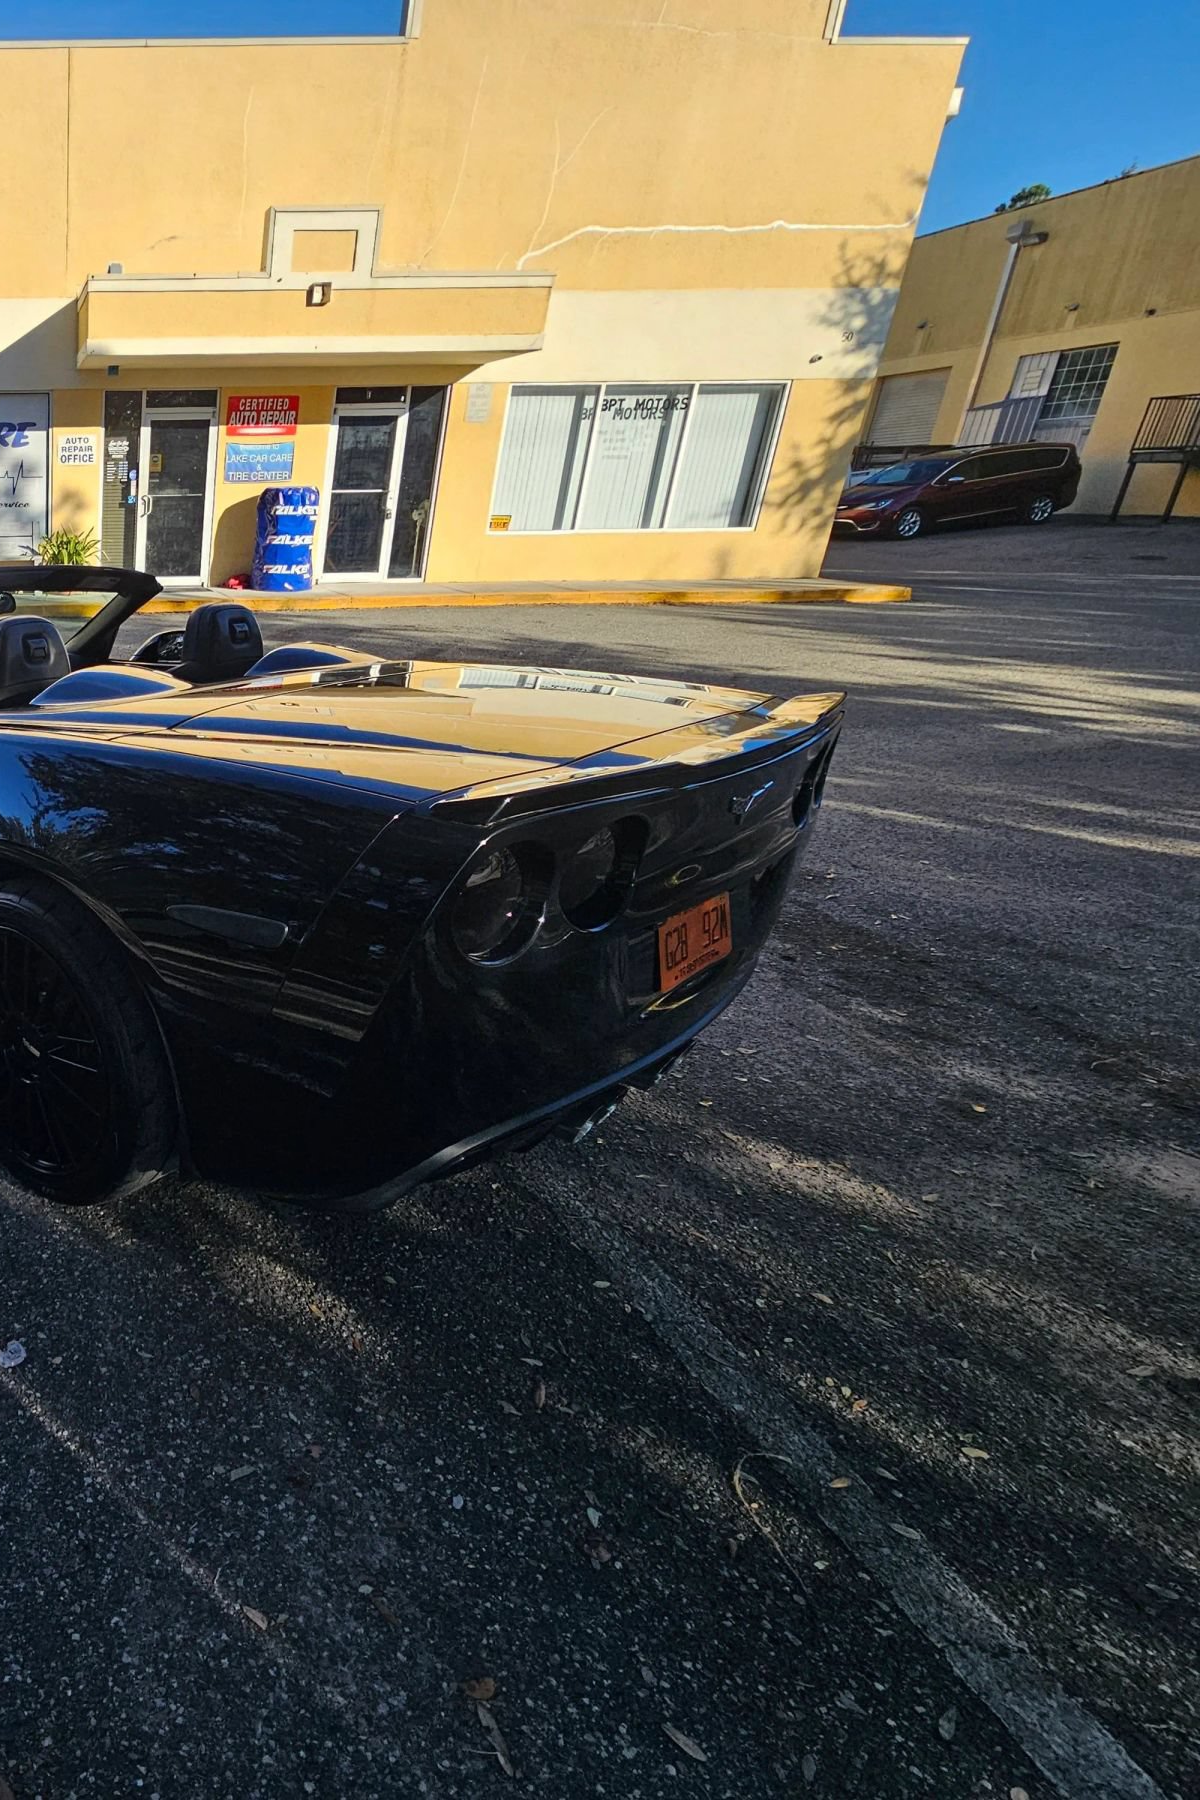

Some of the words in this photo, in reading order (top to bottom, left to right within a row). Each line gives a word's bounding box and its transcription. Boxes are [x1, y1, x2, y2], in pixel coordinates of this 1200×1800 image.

[239, 398, 289, 410] CERTIFIED
[633, 397, 689, 412] MOTORS
[229, 411, 257, 426] AUTO
[259, 411, 296, 426] REPAIR
[65, 437, 89, 445] AUTO
[61, 445, 93, 453] REPAIR
[60, 454, 94, 463] OFFICE
[226, 454, 248, 463] LAKE
[249, 454, 268, 463] CAR
[270, 453, 293, 463] CARE
[256, 463, 262, 471] &
[228, 471, 249, 481] TIRE
[250, 471, 289, 480] CENTER
[266, 534, 313, 545] FALKE
[263, 564, 309, 575] FALKE
